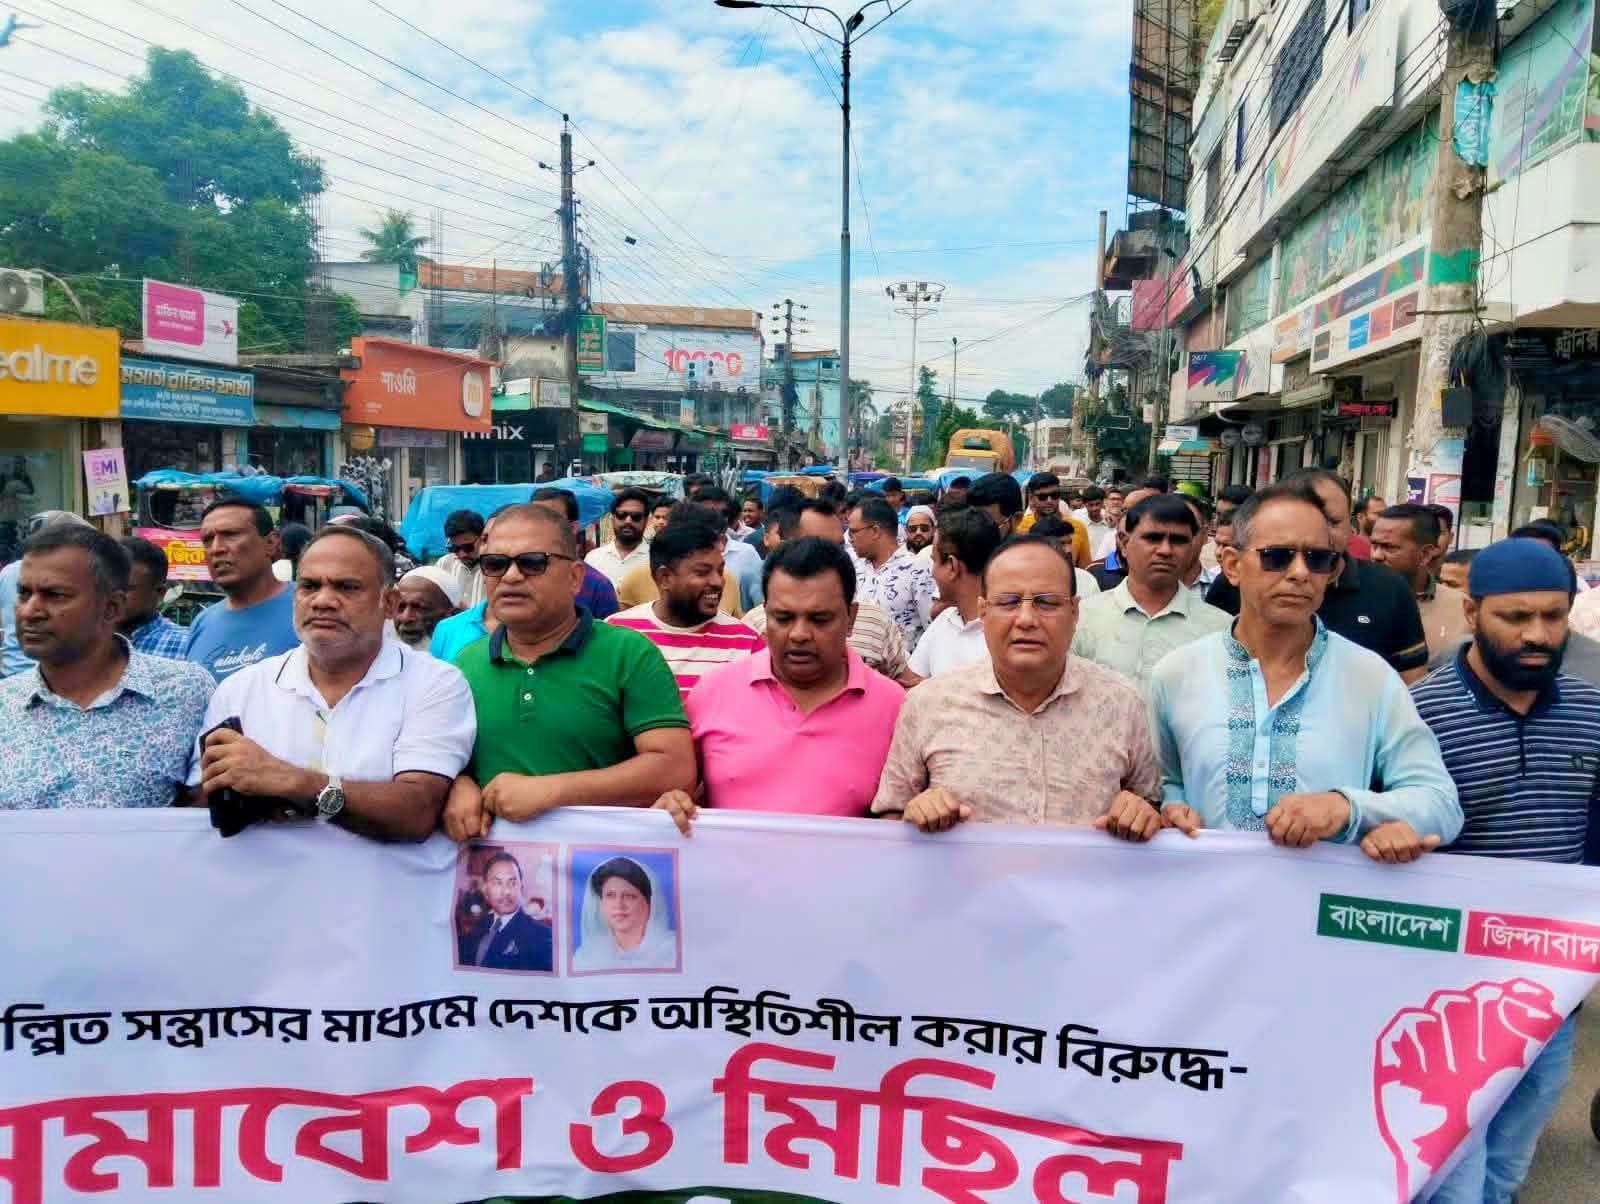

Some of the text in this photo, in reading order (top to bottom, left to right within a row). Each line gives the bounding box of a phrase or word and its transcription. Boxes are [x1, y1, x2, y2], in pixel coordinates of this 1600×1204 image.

[92, 459, 118, 475] EMI
[1328, 904, 1600, 964] বাংলাদেশ জিন্দাবাদ
[122, 1005, 312, 1048] সন্ত্রাসের
[322, 995, 478, 1043] মাধ্যমে
[489, 998, 639, 1034] দেশকে
[648, 985, 902, 1047] অস্থিতিশীল
[911, 1015, 1047, 1065] করার
[569, 1080, 674, 1173] ও
[712, 1042, 1183, 1204] মিছিল
